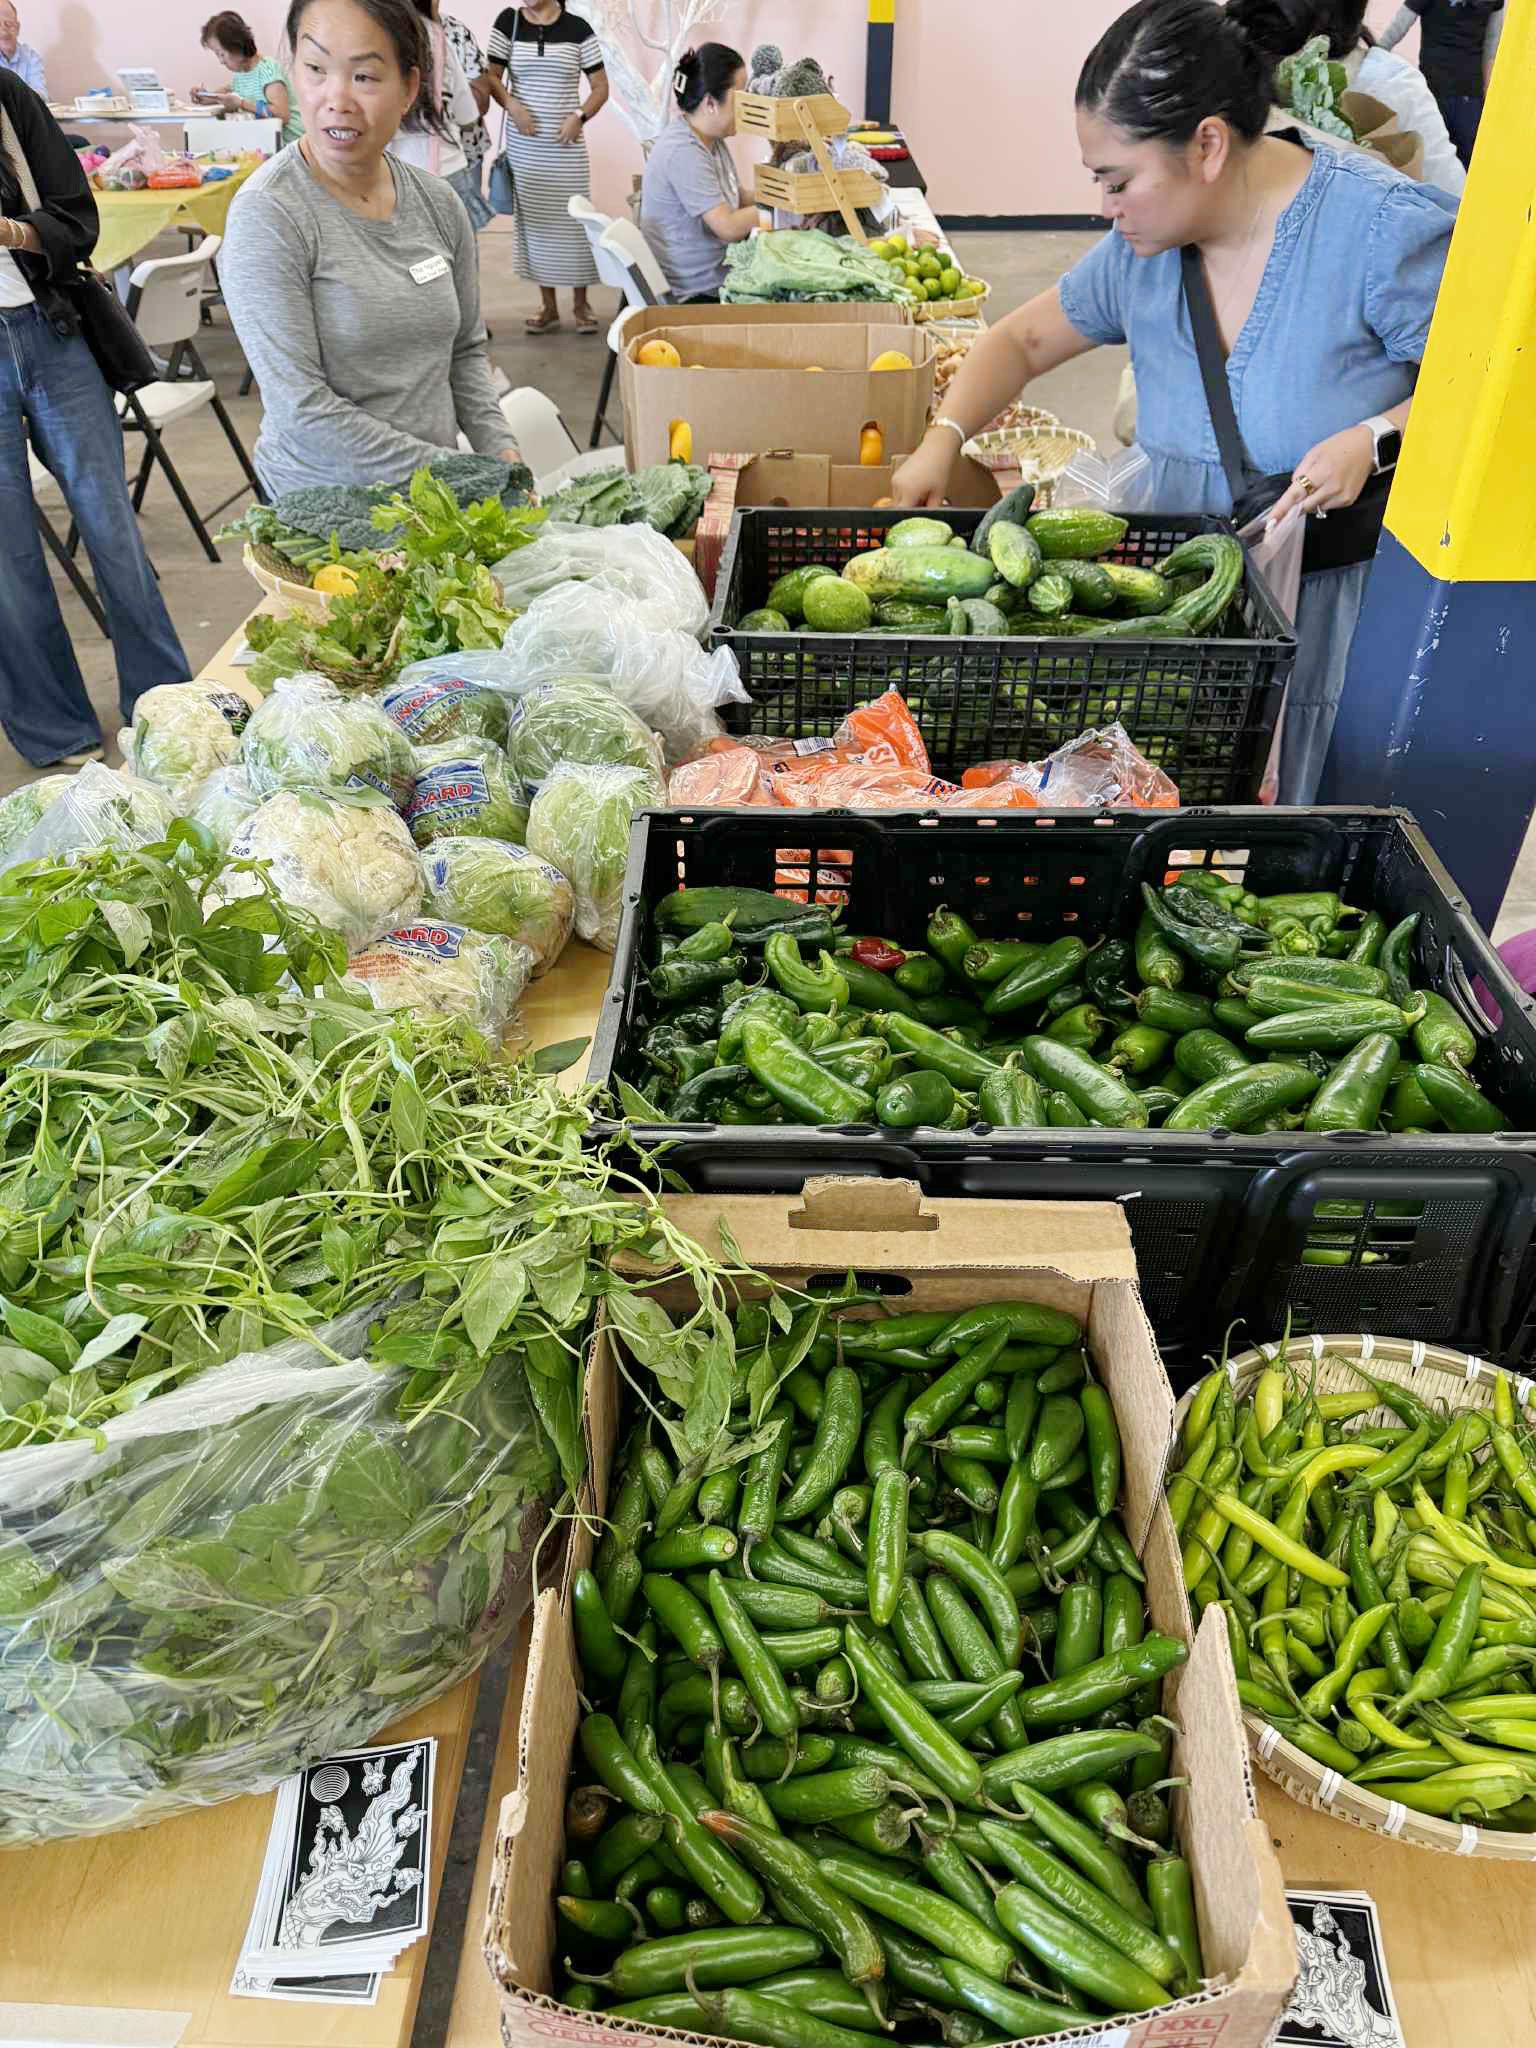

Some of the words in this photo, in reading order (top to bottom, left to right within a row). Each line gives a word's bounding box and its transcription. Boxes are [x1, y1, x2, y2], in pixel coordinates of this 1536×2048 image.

[408, 783, 474, 813] GARD
[1158, 2019, 1217, 2032] XXL
[550, 2028, 641, 2047] YELLOW
